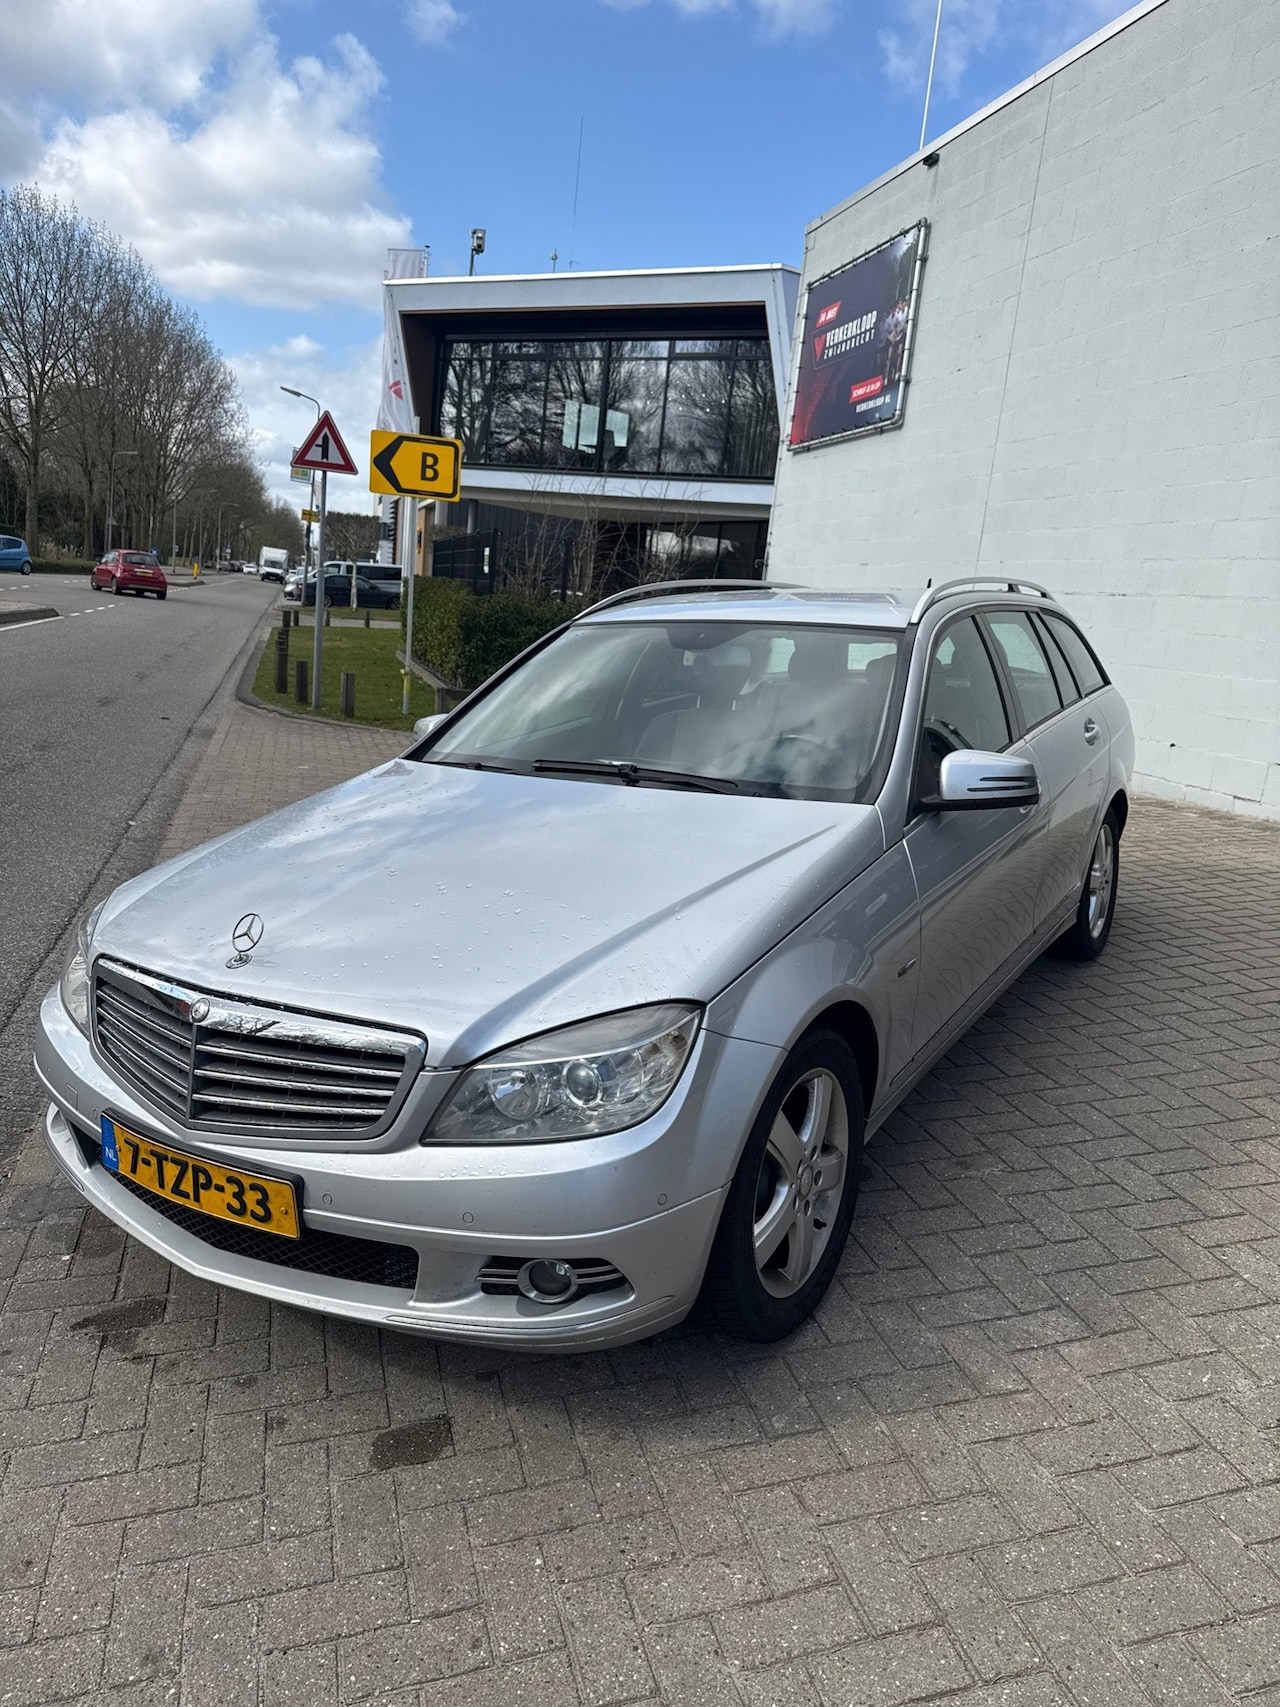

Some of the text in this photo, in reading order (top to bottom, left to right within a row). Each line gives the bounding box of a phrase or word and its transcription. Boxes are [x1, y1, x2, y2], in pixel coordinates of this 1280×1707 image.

[826, 310, 877, 347] VERKERKLOOP
[420, 452, 439, 481] B
[105, 1147, 117, 1162] NL
[123, 1137, 272, 1223] 7-TZP-33
